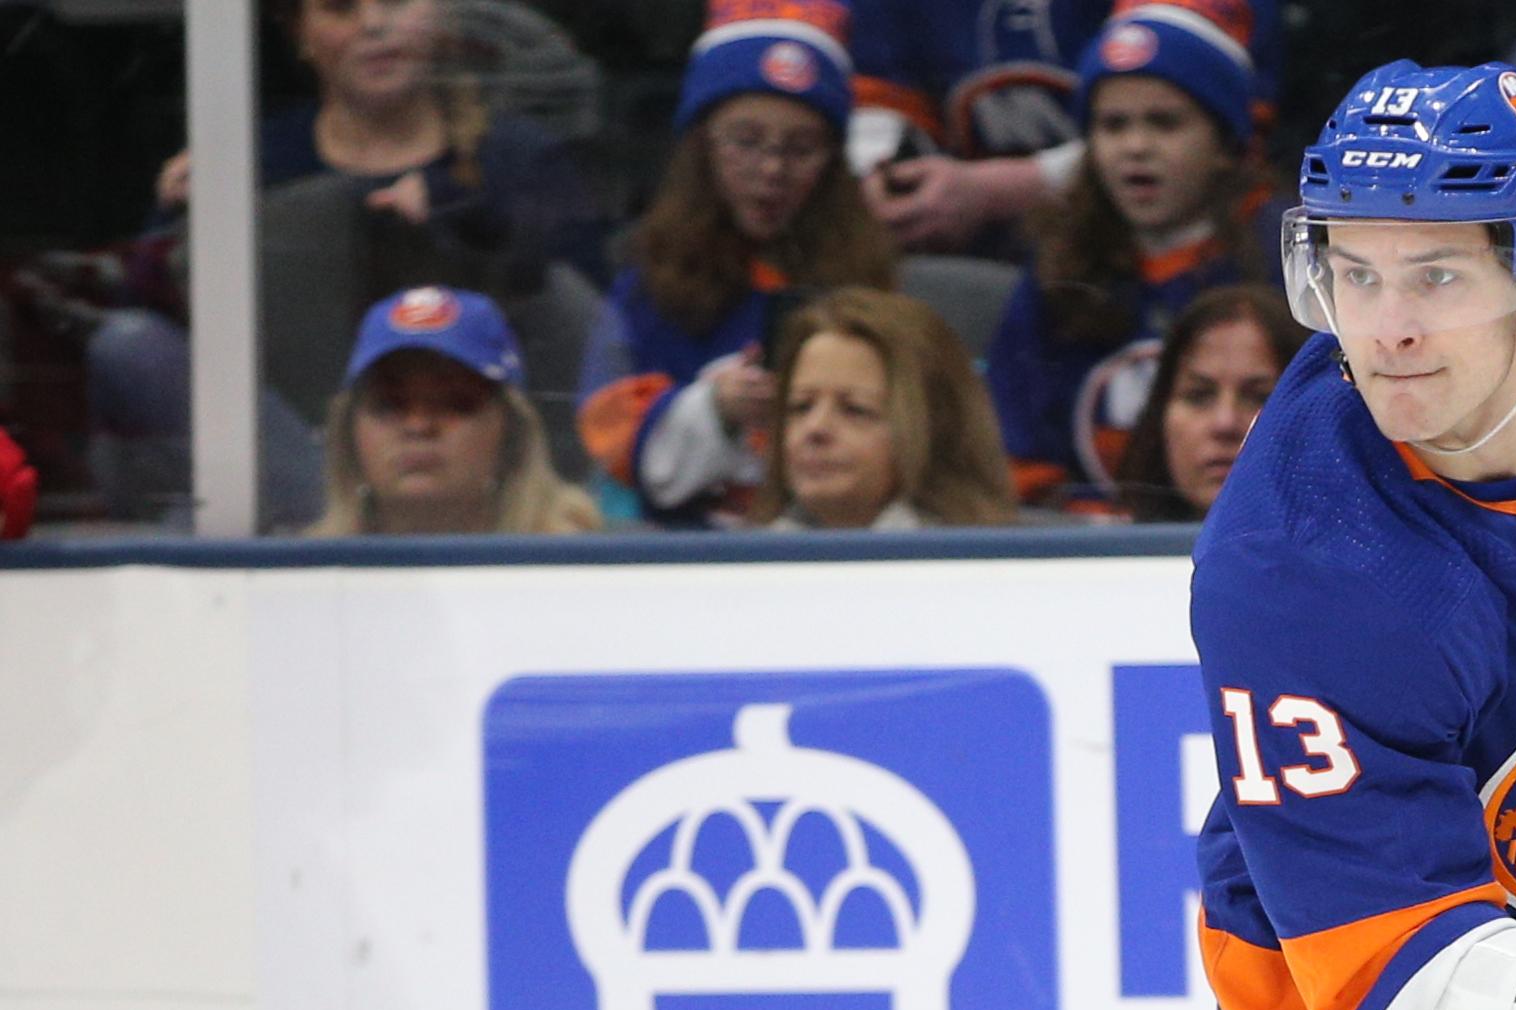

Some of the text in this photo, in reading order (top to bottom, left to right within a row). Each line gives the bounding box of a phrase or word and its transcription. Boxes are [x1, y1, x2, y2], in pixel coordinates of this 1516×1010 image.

[1371, 87, 1420, 116] 13
[1341, 150, 1423, 169] CCM
[1220, 687, 1362, 806] 13
